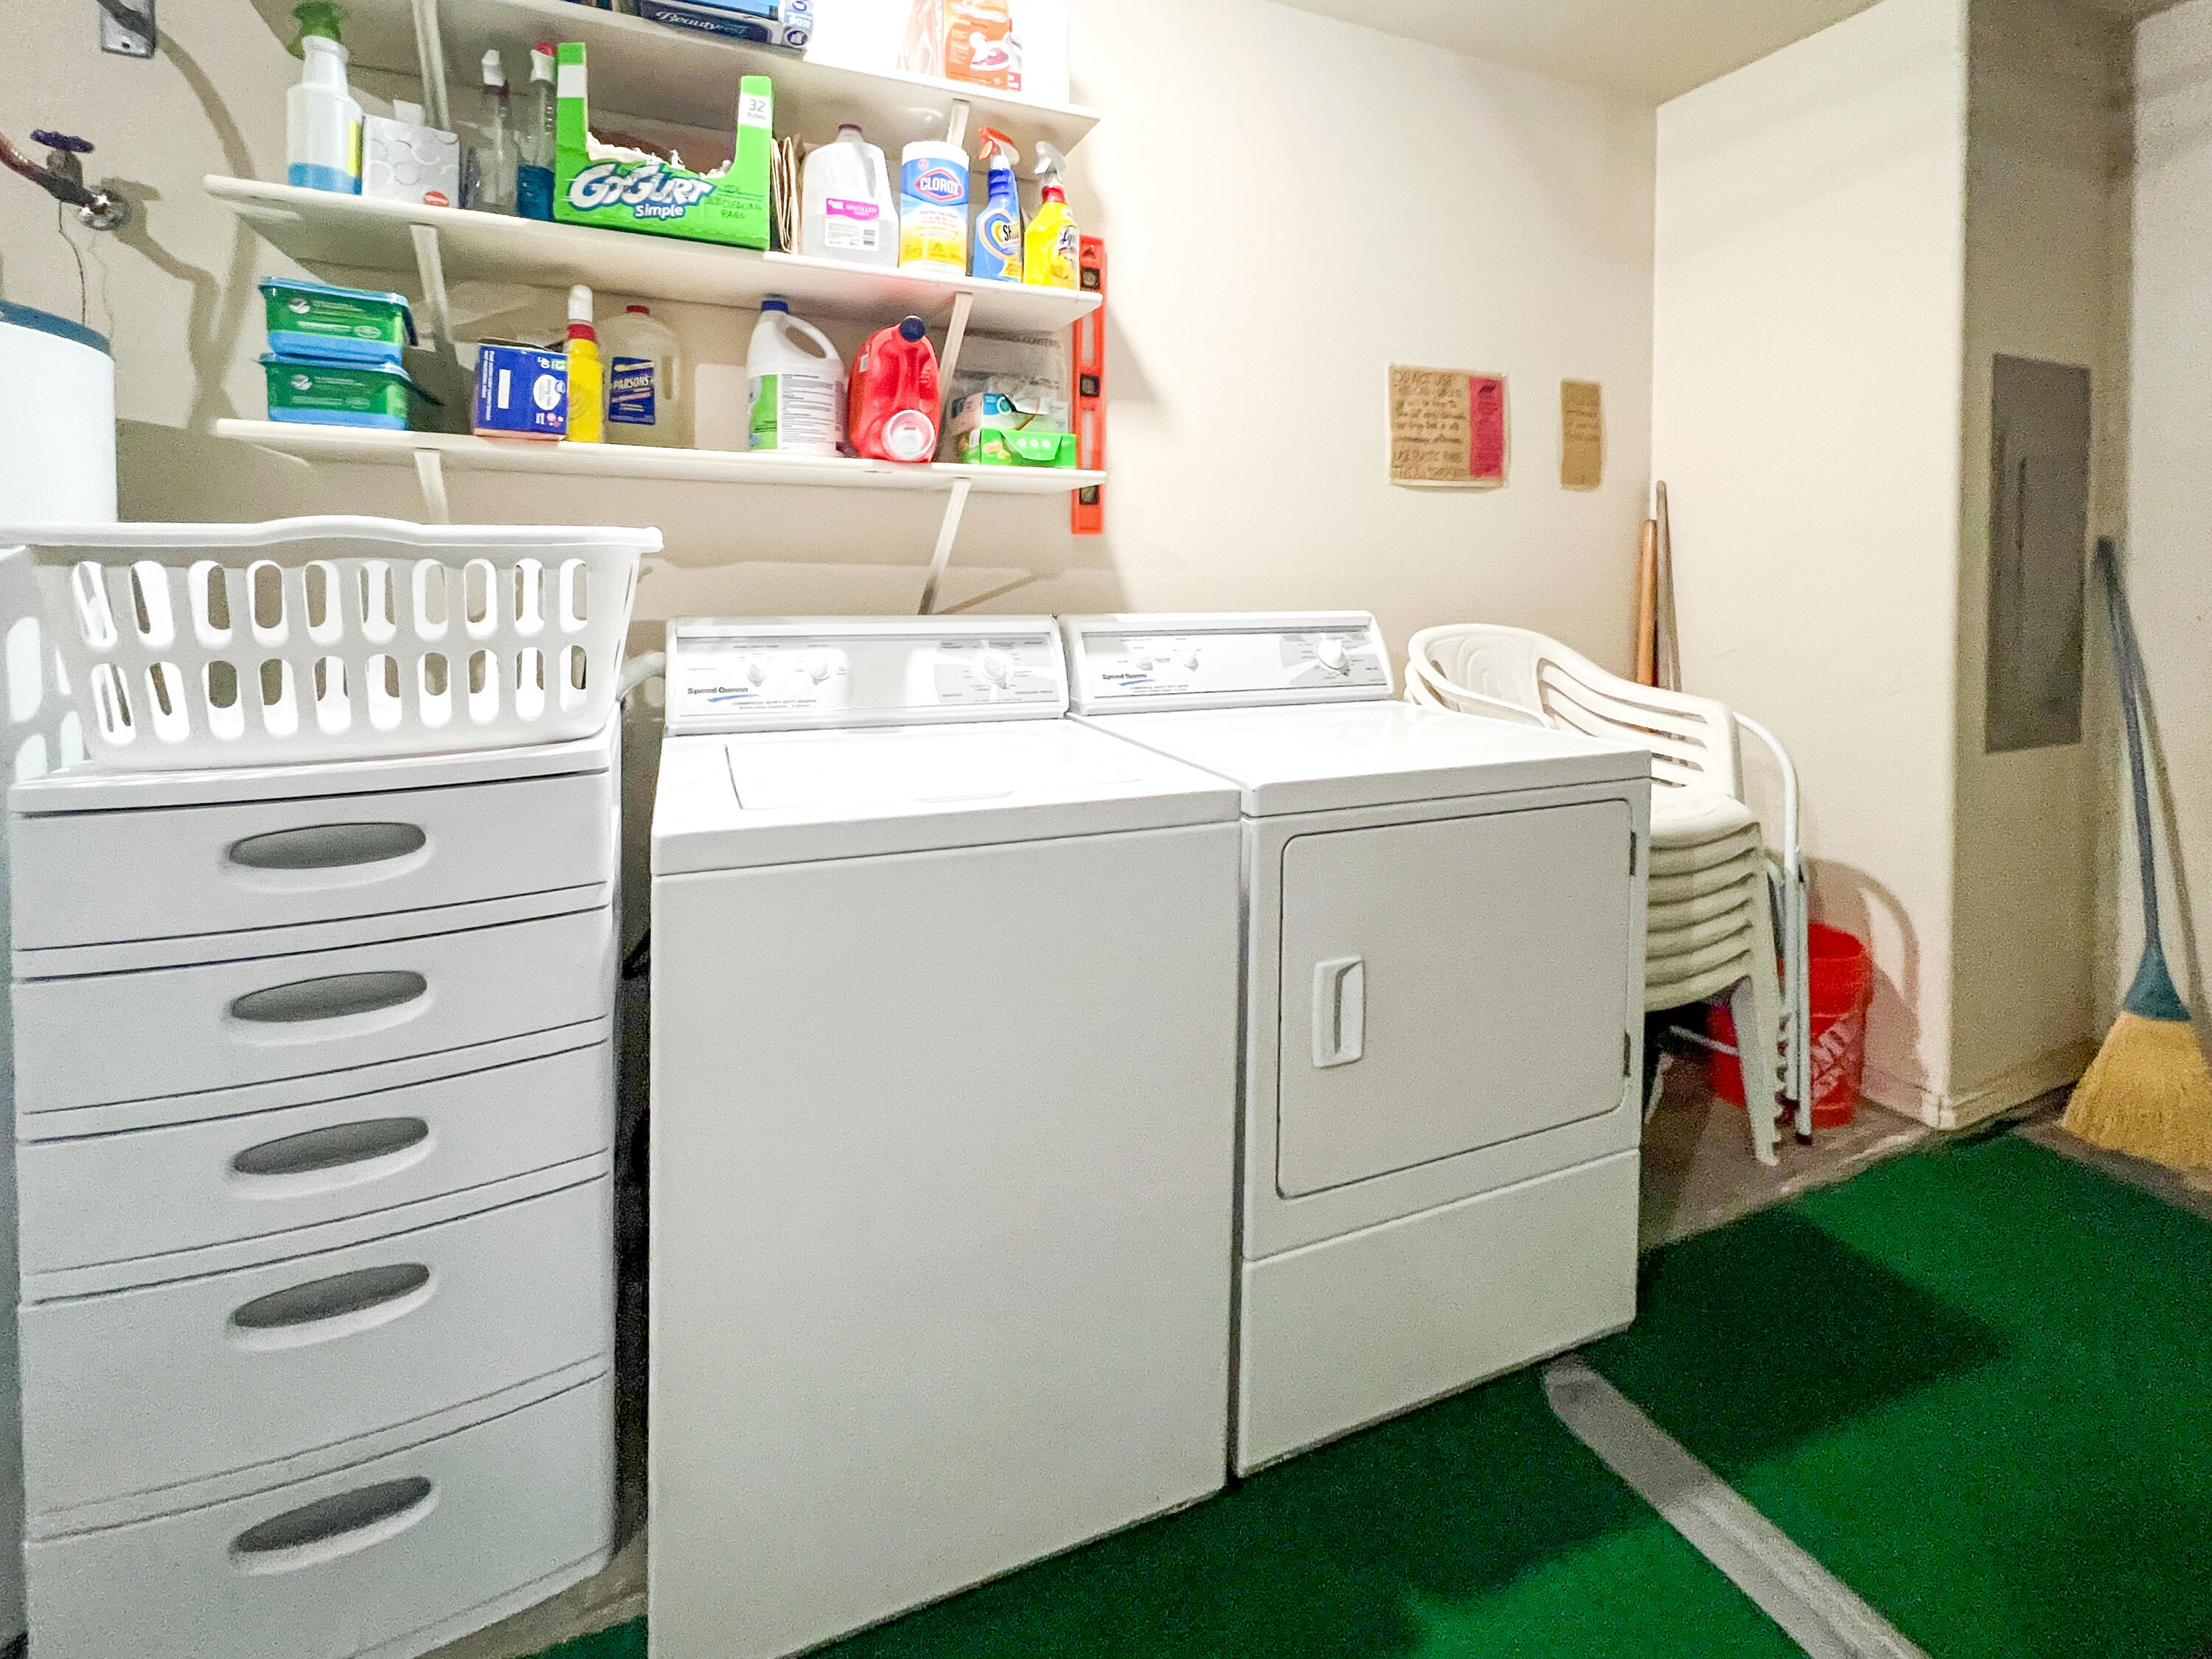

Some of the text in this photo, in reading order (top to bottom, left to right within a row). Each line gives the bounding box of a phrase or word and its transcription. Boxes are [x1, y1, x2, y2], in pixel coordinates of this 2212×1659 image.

[748, 99, 765, 113] 32
[919, 176, 959, 196] CLOROX
[687, 687, 717, 695] Speed
